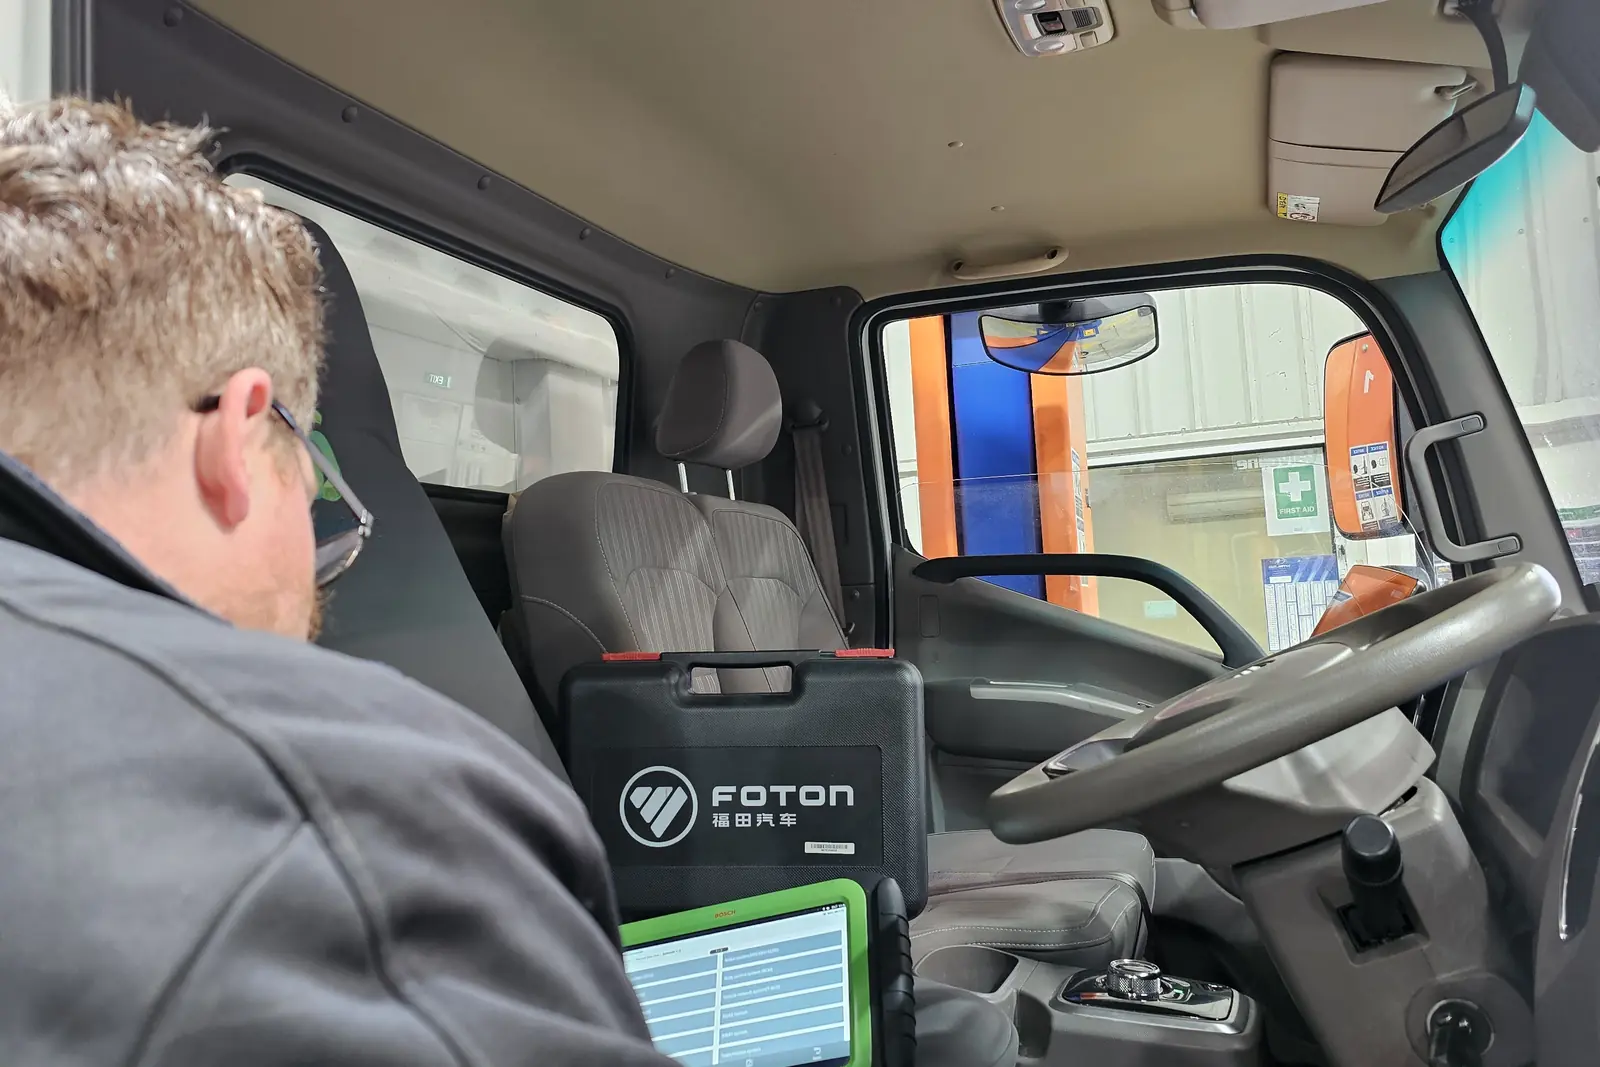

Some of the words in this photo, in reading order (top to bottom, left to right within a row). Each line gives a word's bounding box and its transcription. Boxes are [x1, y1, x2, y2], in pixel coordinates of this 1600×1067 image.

[1279, 507, 1300, 515] FIRST
[711, 785, 854, 807] FOTON
[712, 813, 797, 828] 福田汽车
[714, 909, 736, 919] BOSCH
